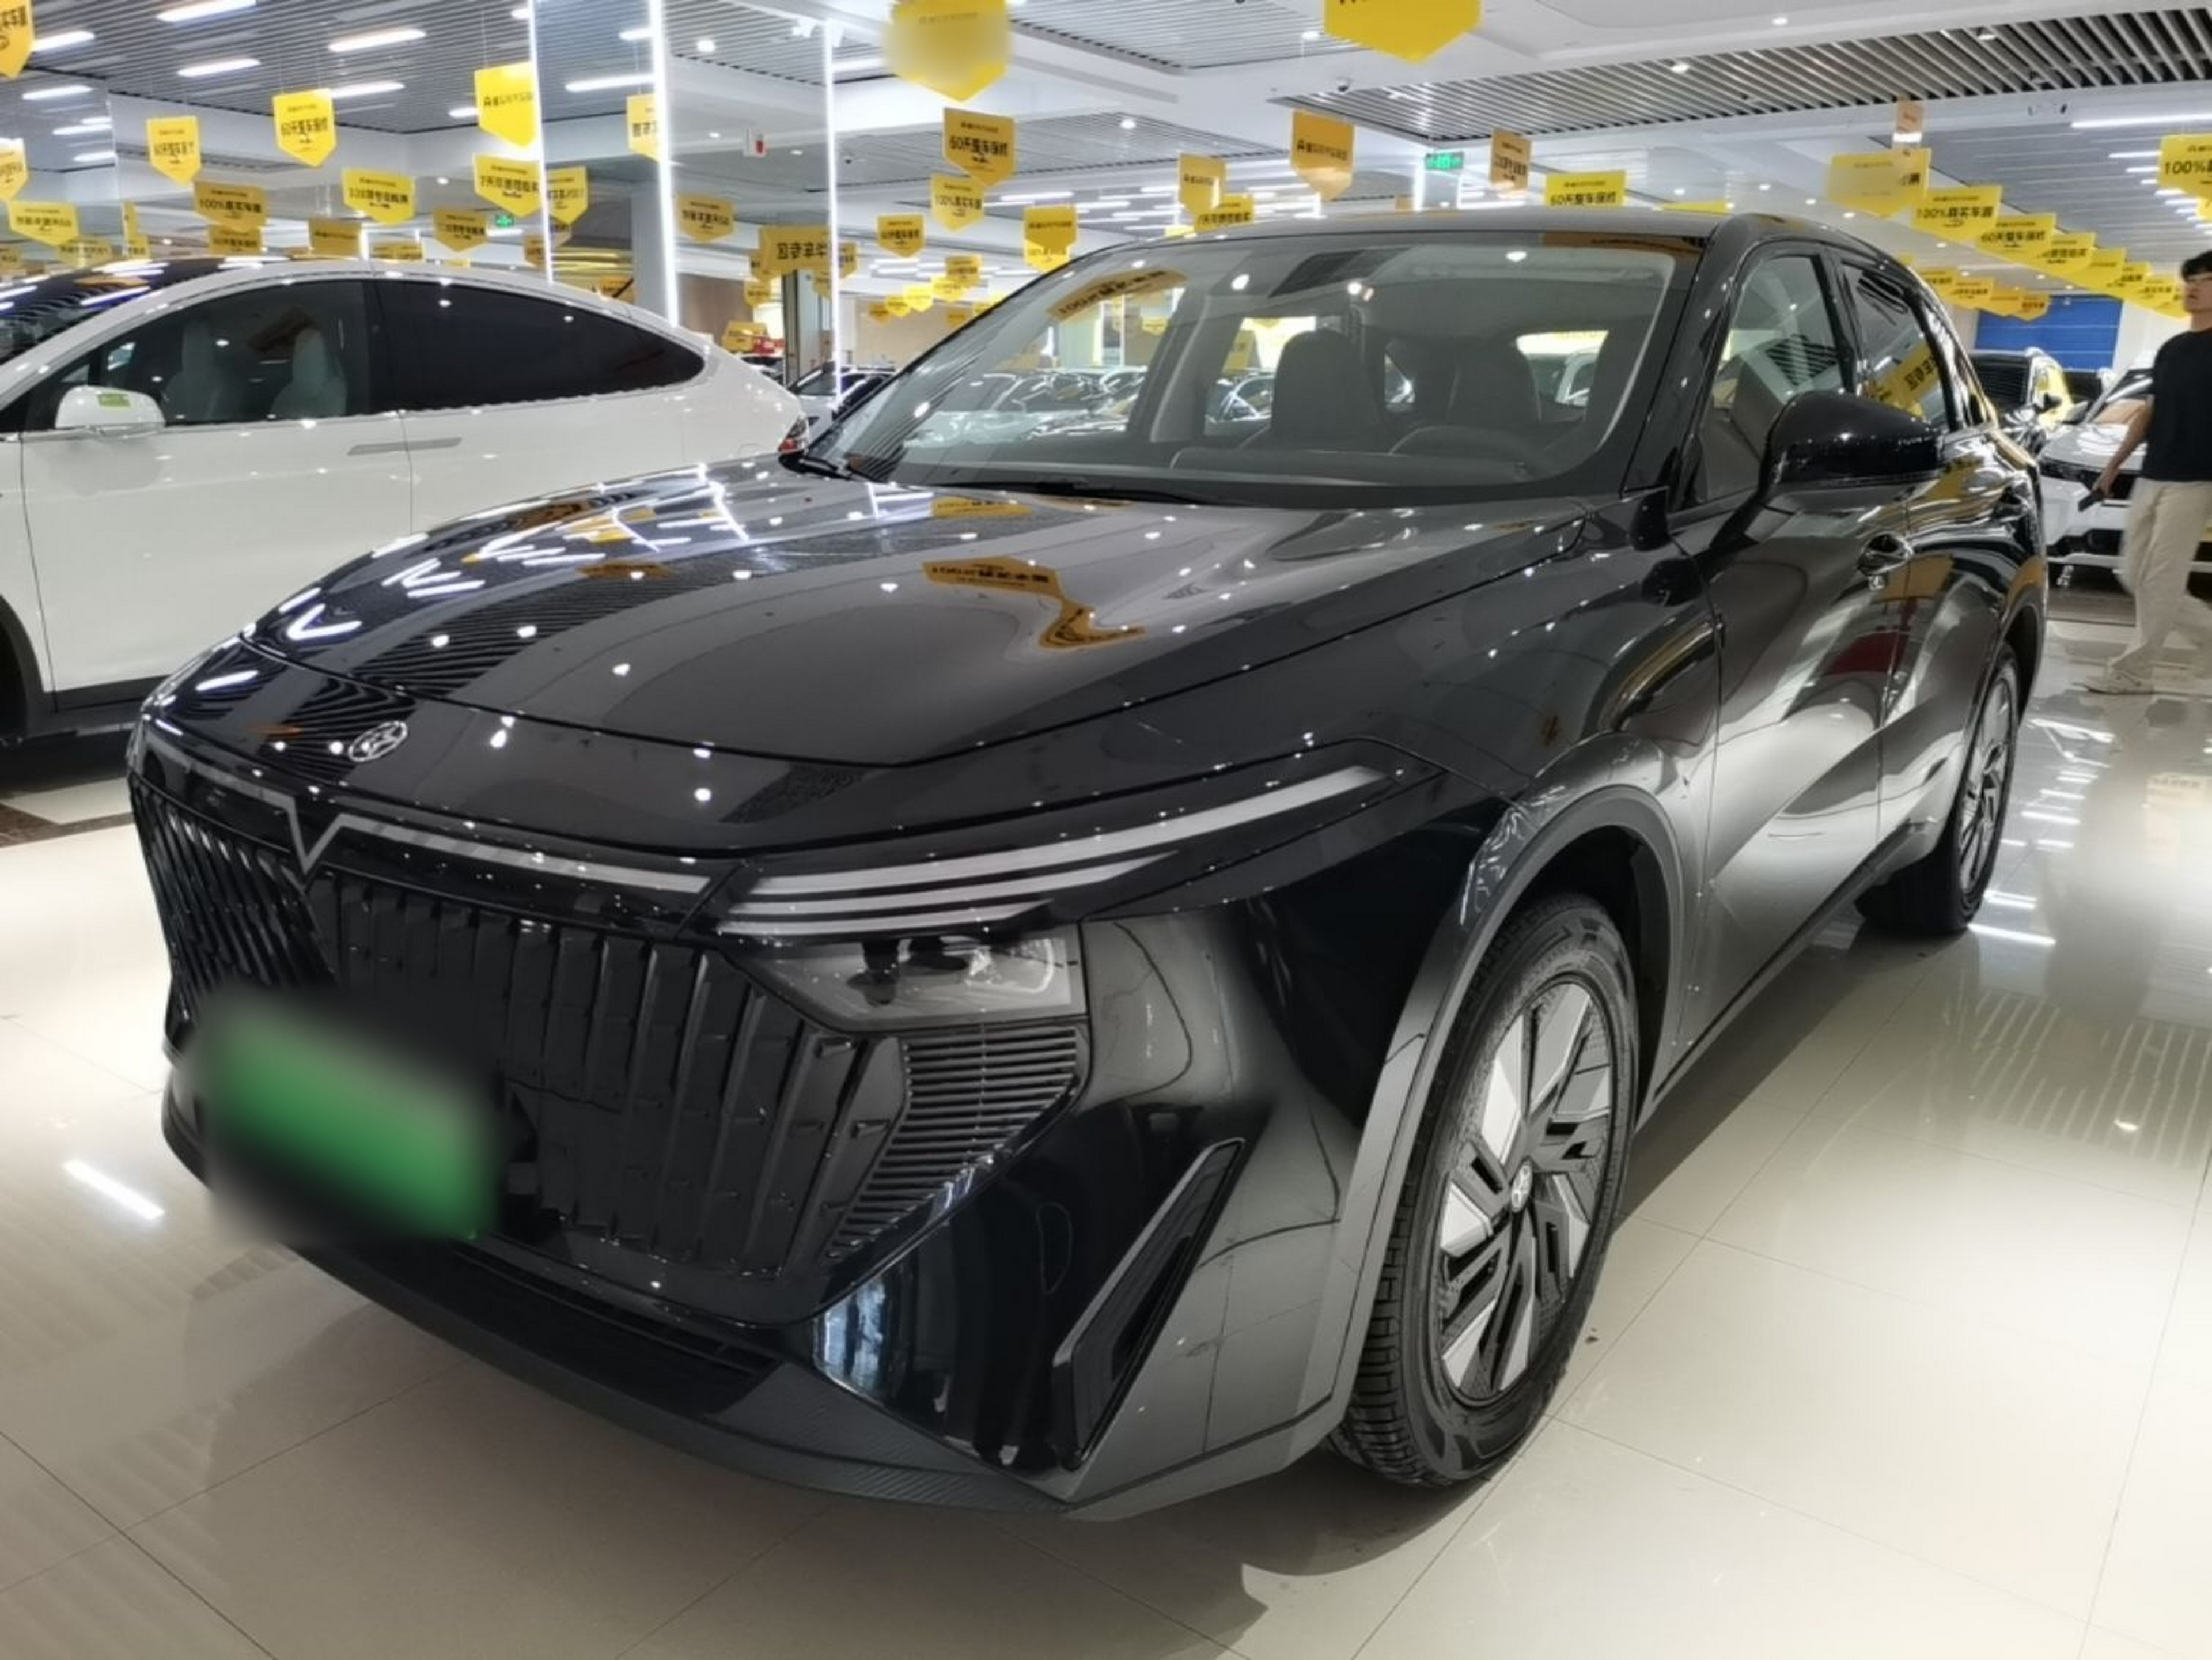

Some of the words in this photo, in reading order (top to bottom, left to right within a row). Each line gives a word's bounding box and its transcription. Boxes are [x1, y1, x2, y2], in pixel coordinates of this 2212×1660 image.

[949, 135, 1008, 156] 60天整车保修
